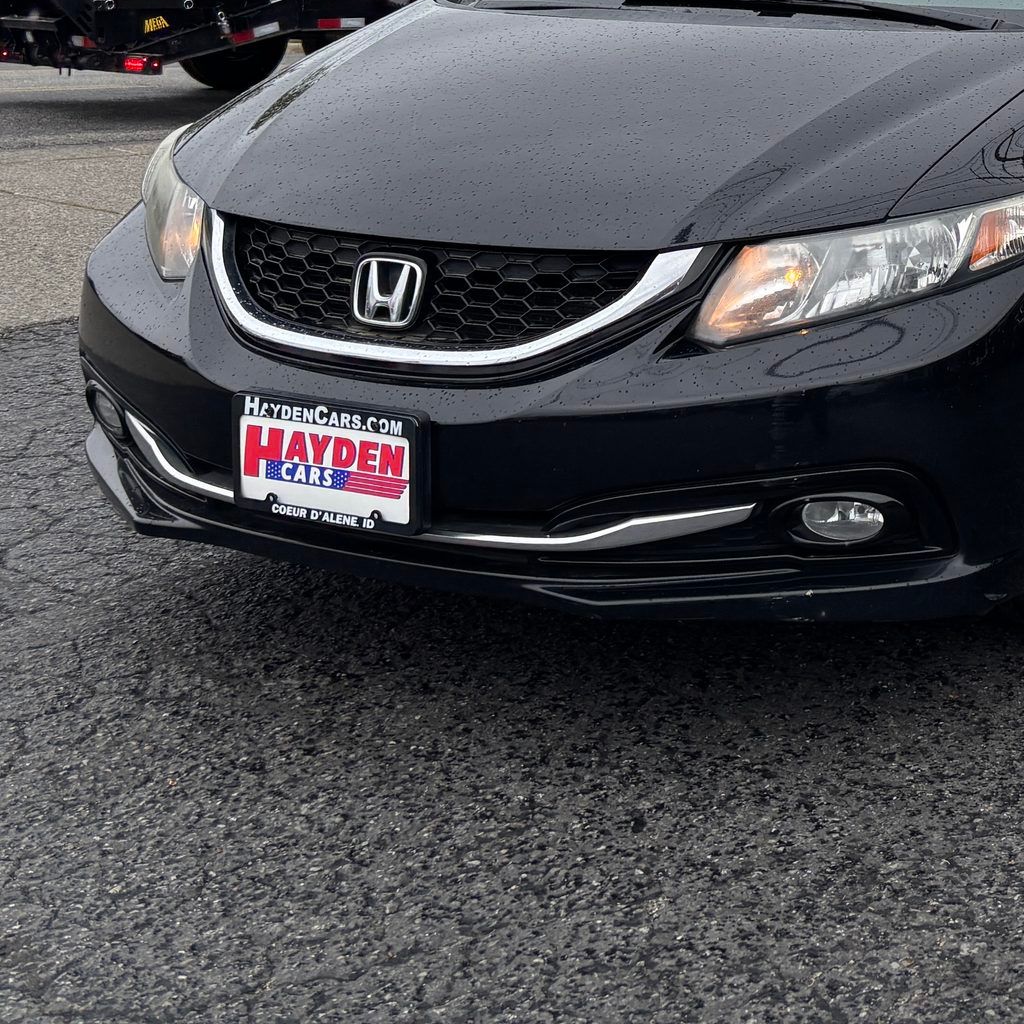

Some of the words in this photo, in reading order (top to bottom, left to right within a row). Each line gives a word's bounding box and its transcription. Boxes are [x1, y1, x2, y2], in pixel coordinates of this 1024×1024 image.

[144, 16, 170, 34] MEGA
[243, 424, 405, 478] HAYDEN
[280, 463, 335, 487] CARS
[271, 503, 307, 519] COEUR
[362, 518, 375, 529] ID
